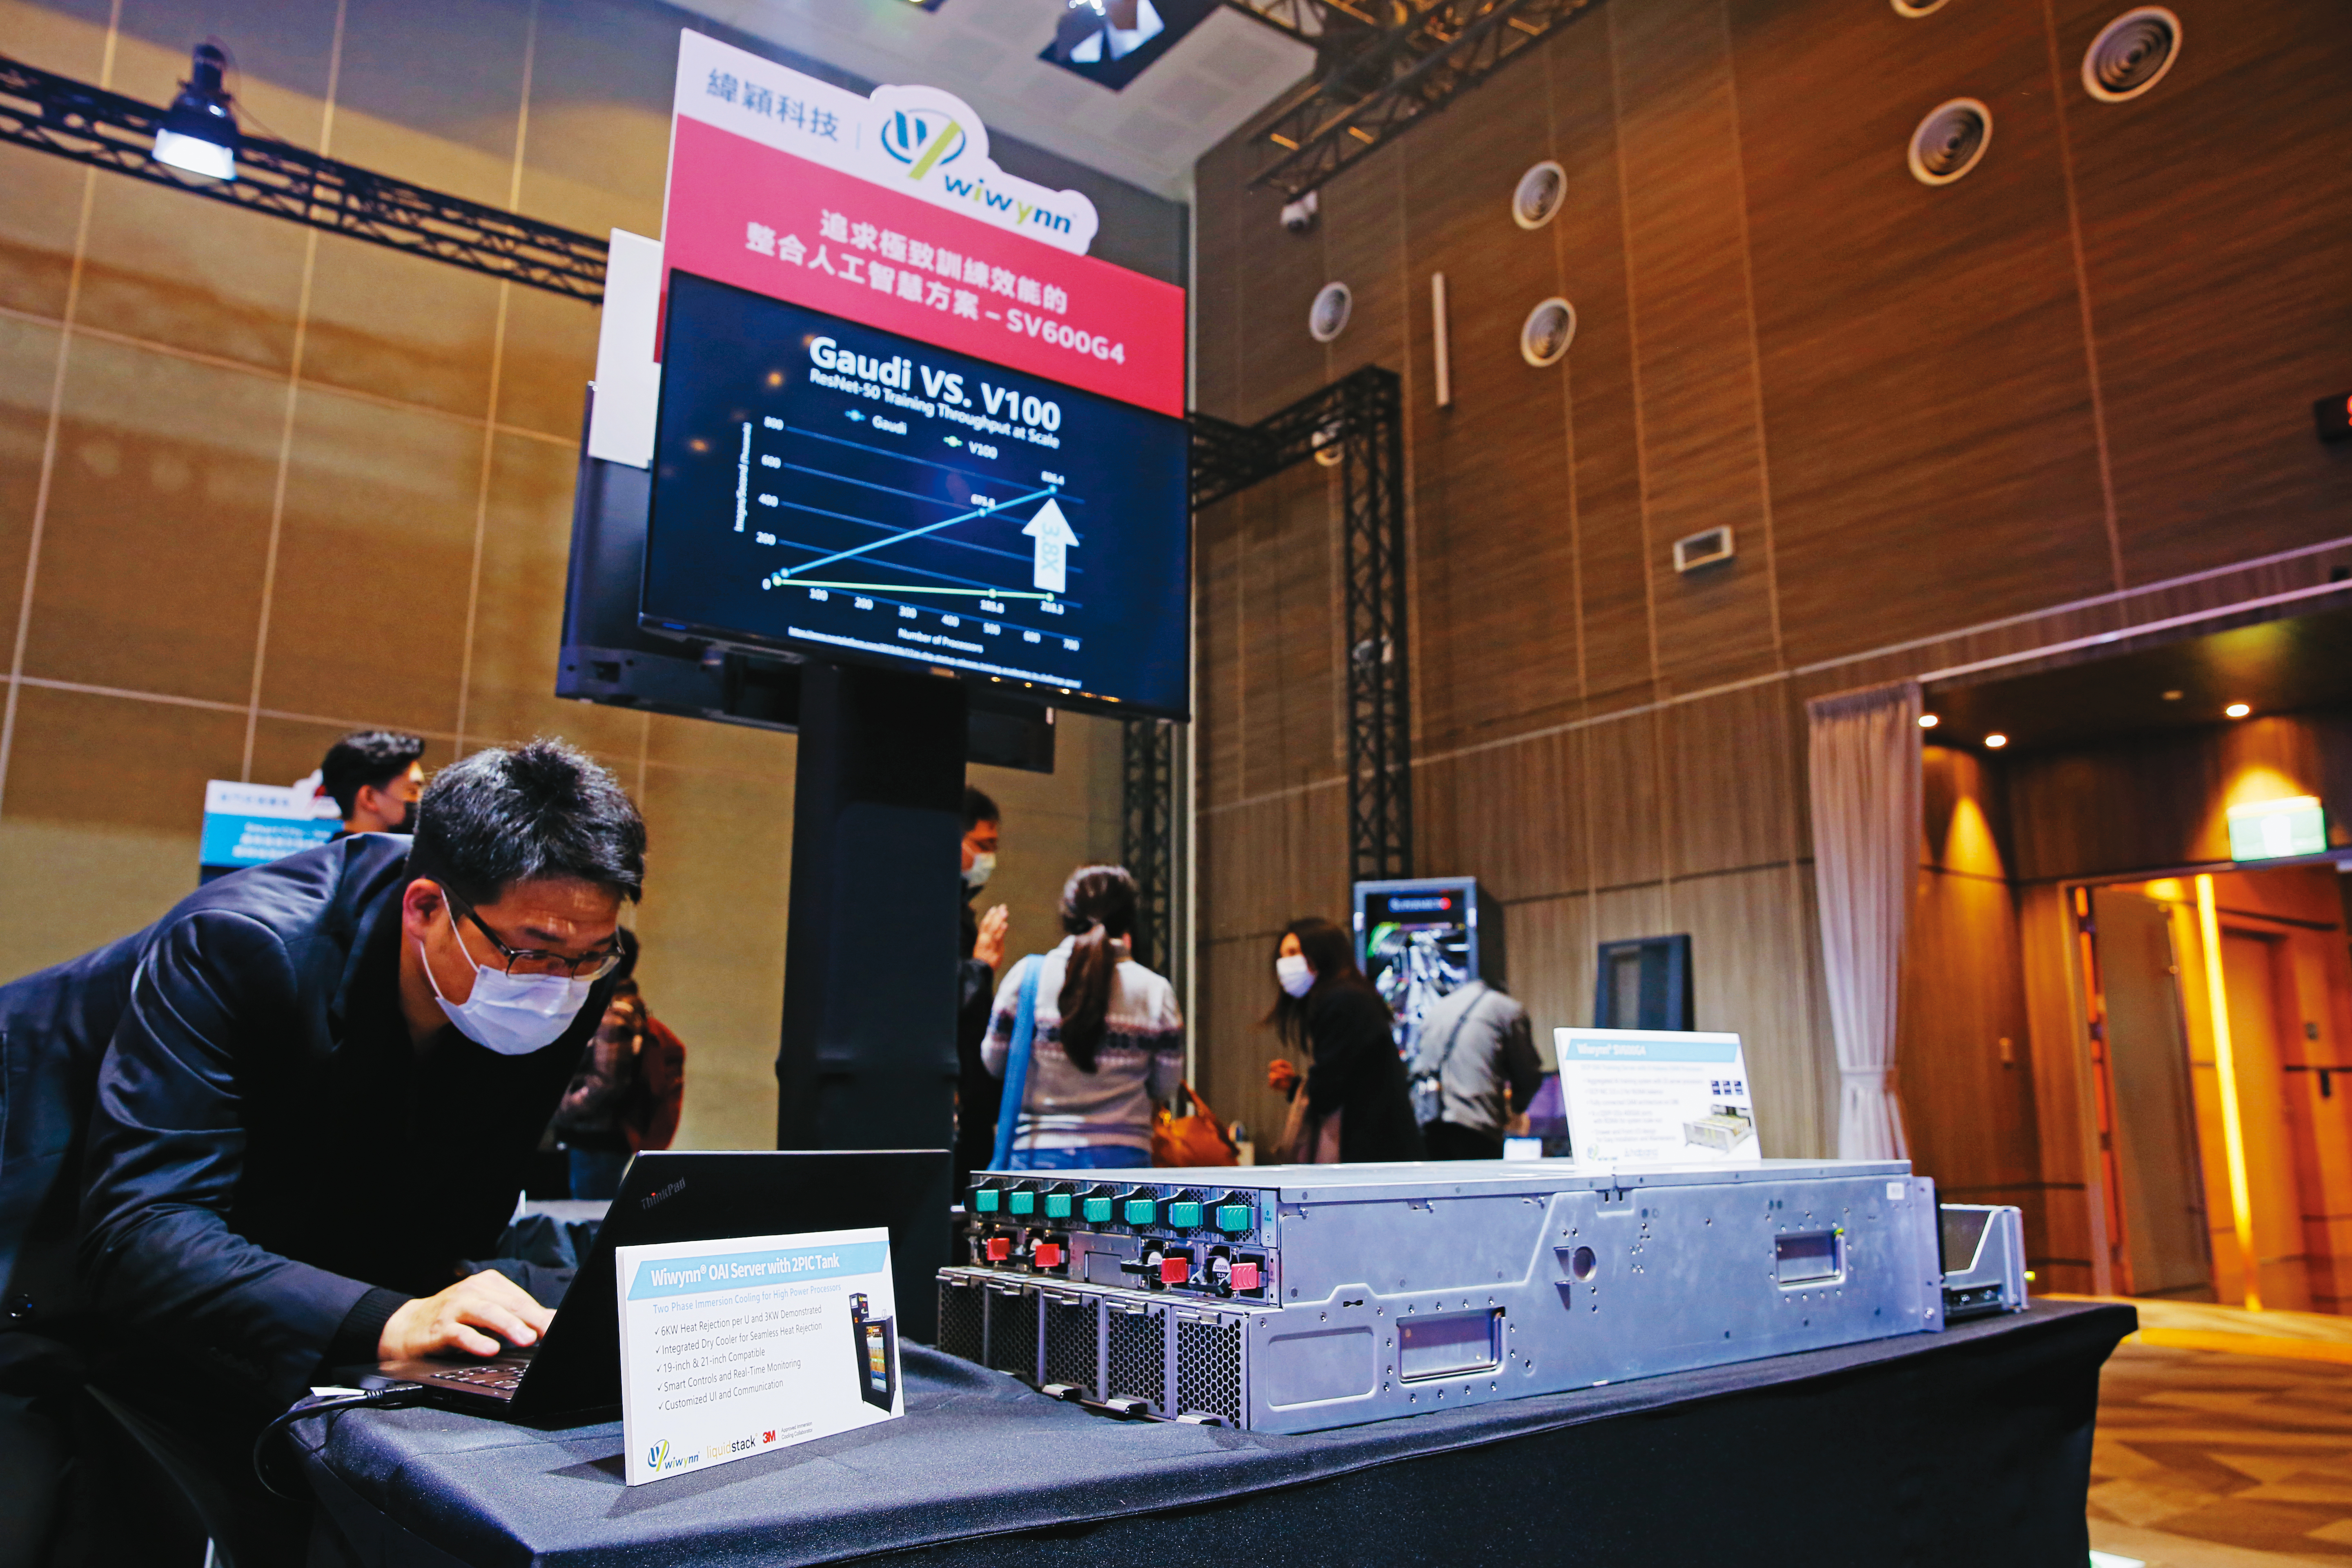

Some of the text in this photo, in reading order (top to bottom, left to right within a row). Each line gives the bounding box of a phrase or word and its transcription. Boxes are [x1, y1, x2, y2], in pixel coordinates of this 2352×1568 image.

[945, 174, 1071, 233] wiwynn
[820, 209, 1067, 314] 追求極致訓練效能的
[810, 336, 1060, 431] Gaudi VS. V100
[810, 368, 1060, 449] ResNet-50 Training Throughput at Scale
[872, 415, 907, 435] Gaudi
[969, 441, 998, 459] V100
[898, 628, 984, 653] Number of Processors
[641, 1177, 686, 1209] ThinkPad
[709, 1264, 728, 1281] OAI
[731, 1262, 765, 1278] Server
[766, 1257, 791, 1275] with
[792, 1255, 815, 1272] 2PIC
[815, 1252, 840, 1268] Tank
[653, 1284, 841, 1314] Two Phase Immersion Cooling for High Power Processors
[661, 1305, 822, 1336] 6KW Heat Rejection per U and 3KW Demonstrated
[662, 1322, 822, 1355] Integrated Dry Cooler for Seamless Heat Rejection
[663, 1347, 765, 1373] 19-inch & 21-inch Compatible
[664, 1358, 801, 1392] Smart Controls and Real-Time Monitoring
[665, 1379, 784, 1410] Customized UI and Communication
[763, 1430, 776, 1444] 3M
[781, 1425, 796, 1433] Approved
[782, 1428, 813, 1440] Cooling Collaborator
[665, 1453, 699, 1469] wiwynn
[707, 1435, 755, 1459] liquidstack
